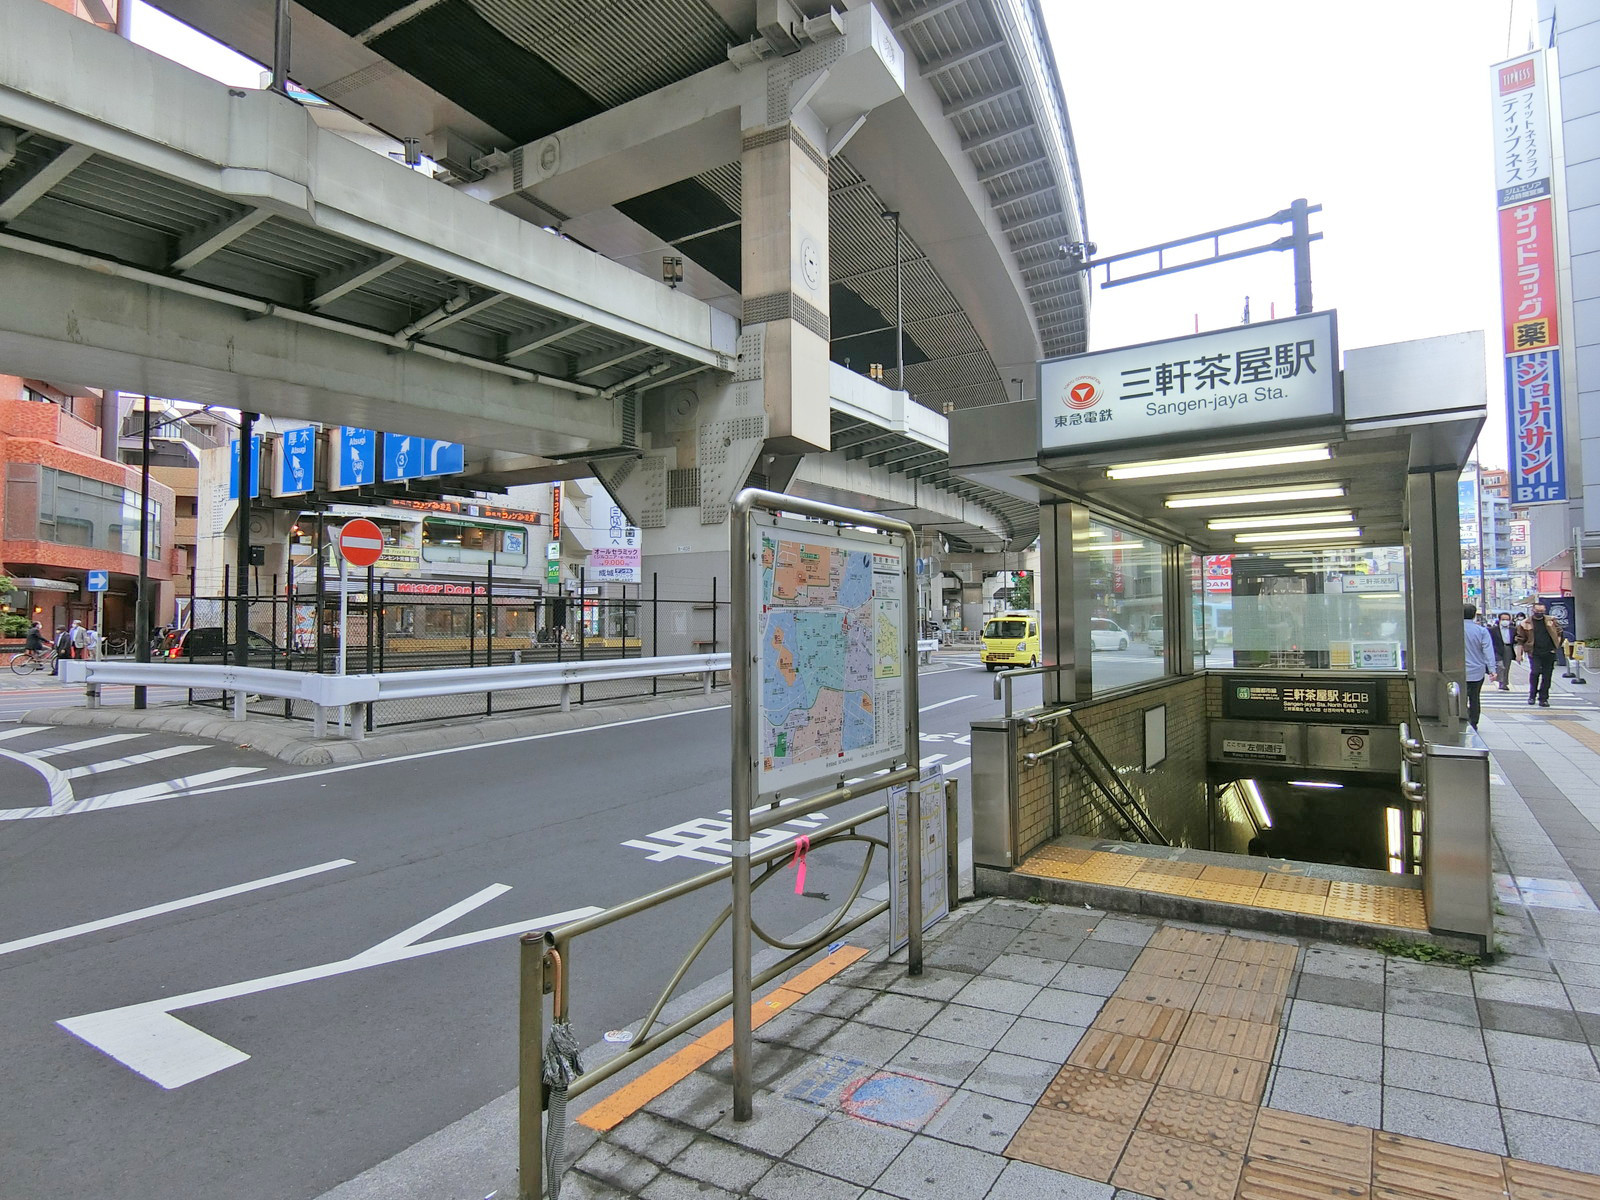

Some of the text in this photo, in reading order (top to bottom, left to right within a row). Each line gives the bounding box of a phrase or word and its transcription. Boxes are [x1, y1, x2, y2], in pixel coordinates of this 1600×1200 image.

[1502, 66, 1531, 86] TIPNESS
[1502, 97, 1524, 184] ティップネス
[1522, 92, 1539, 179] フィットネスクラブ
[1504, 181, 1542, 196] ジムエリア
[1513, 204, 1543, 320] サンドラッグ
[1516, 321, 1547, 348] 薬
[1119, 338, 1317, 401] 三軒茶屋駅
[1146, 385, 1289, 417] Sangen-jaya Sta.
[1053, 408, 1114, 429] 東急電鉄
[1516, 359, 1553, 478] ジョナサン
[287, 430, 310, 446] 厚木
[349, 436, 367, 447] Atsugi
[290, 445, 307, 456] Atsugi
[352, 460, 363, 472] 246
[399, 454, 405, 466] 3
[1517, 484, 1560, 502] B1F
[397, 583, 487, 595] Mister Donut
[1283, 688, 1369, 703] 三軒茶屋駅 北口B
[1247, 743, 1283, 753] 左側通行
